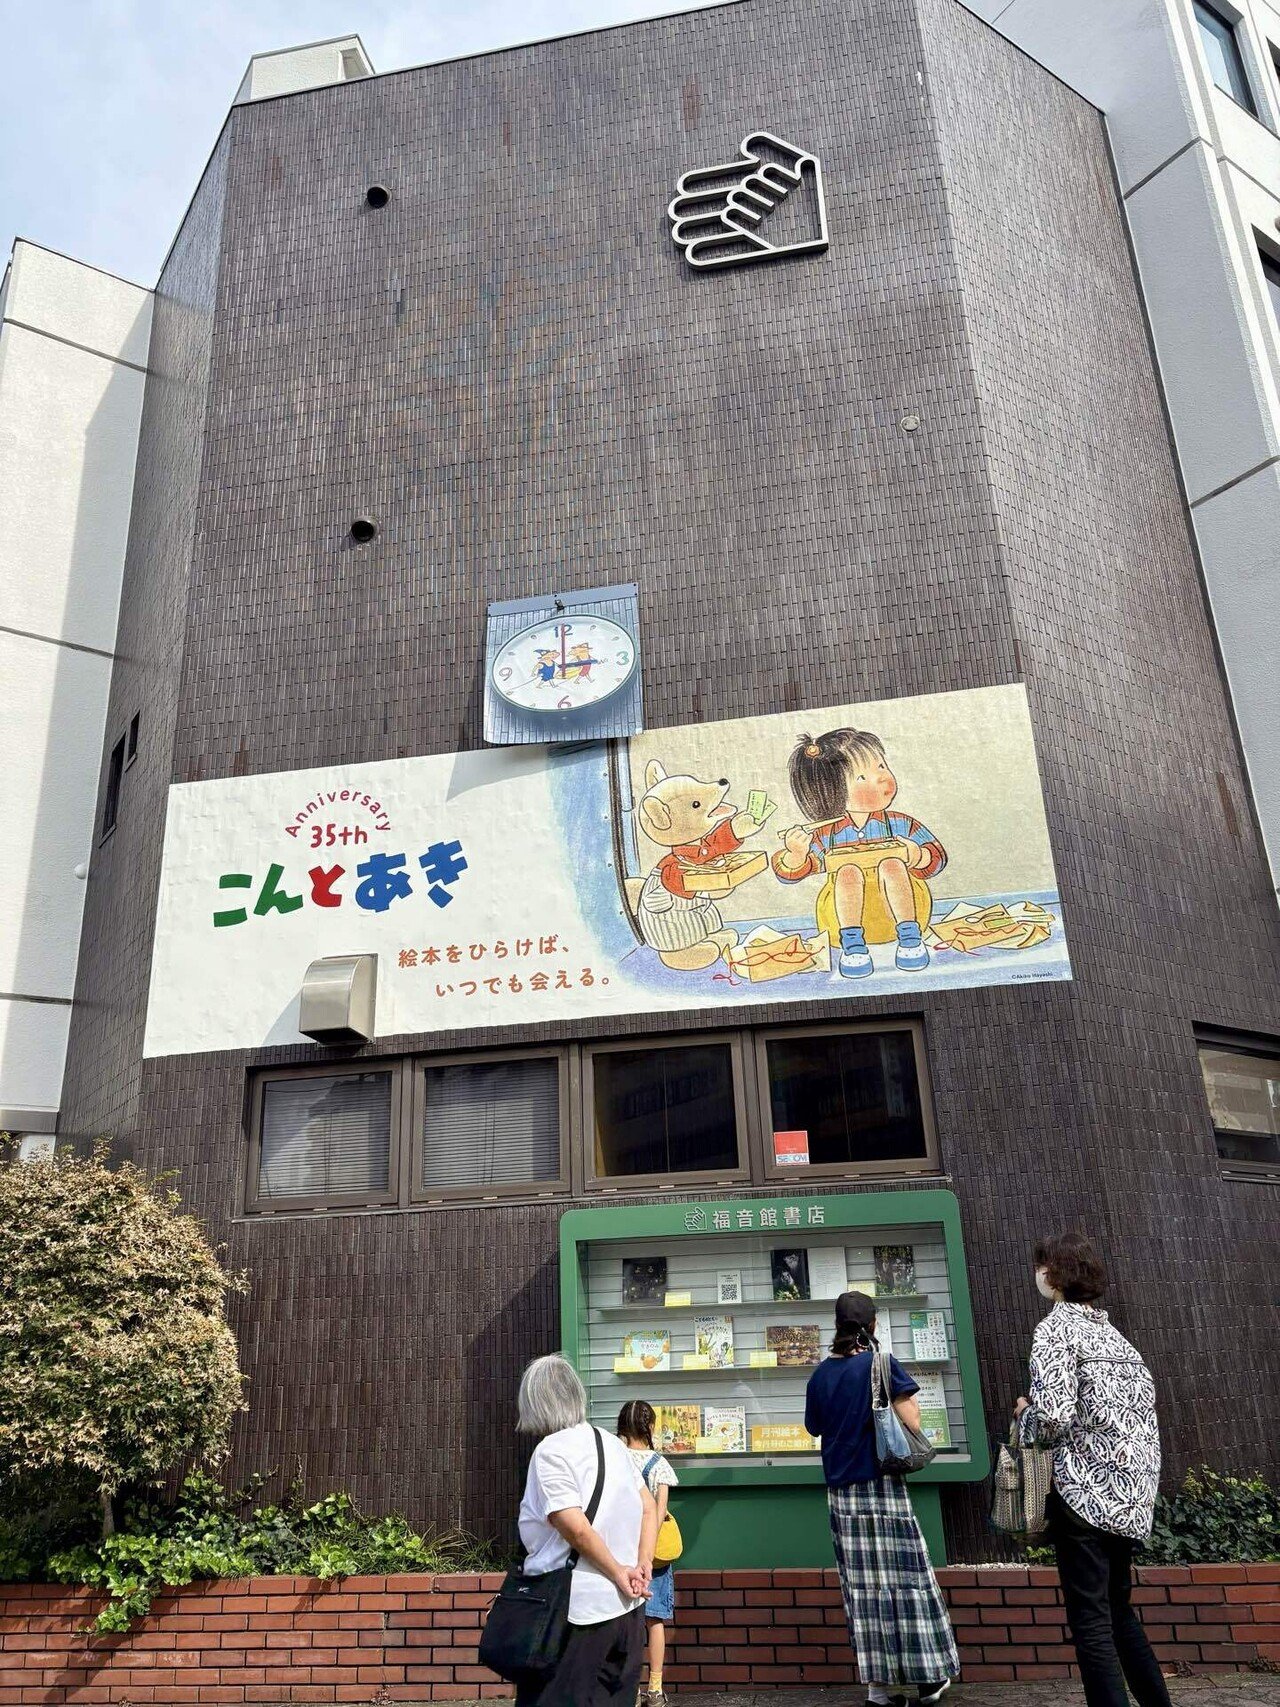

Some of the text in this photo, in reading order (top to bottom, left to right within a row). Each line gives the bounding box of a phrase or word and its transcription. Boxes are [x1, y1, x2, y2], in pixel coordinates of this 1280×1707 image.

[553, 624, 573, 639] 12
[616, 651, 630, 666] 3
[499, 666, 513, 681] 9
[557, 695, 572, 709] 6
[285, 789, 391, 838] Anniversary
[310, 823, 368, 848] 35th
[213, 839, 468, 927] こんとあき
[398, 934, 570, 968] 絵本をひらけば、
[436, 967, 610, 997] いつでも会える。
[777, 1153, 808, 1163] SECOM
[712, 1205, 825, 1230] 福音館書店
